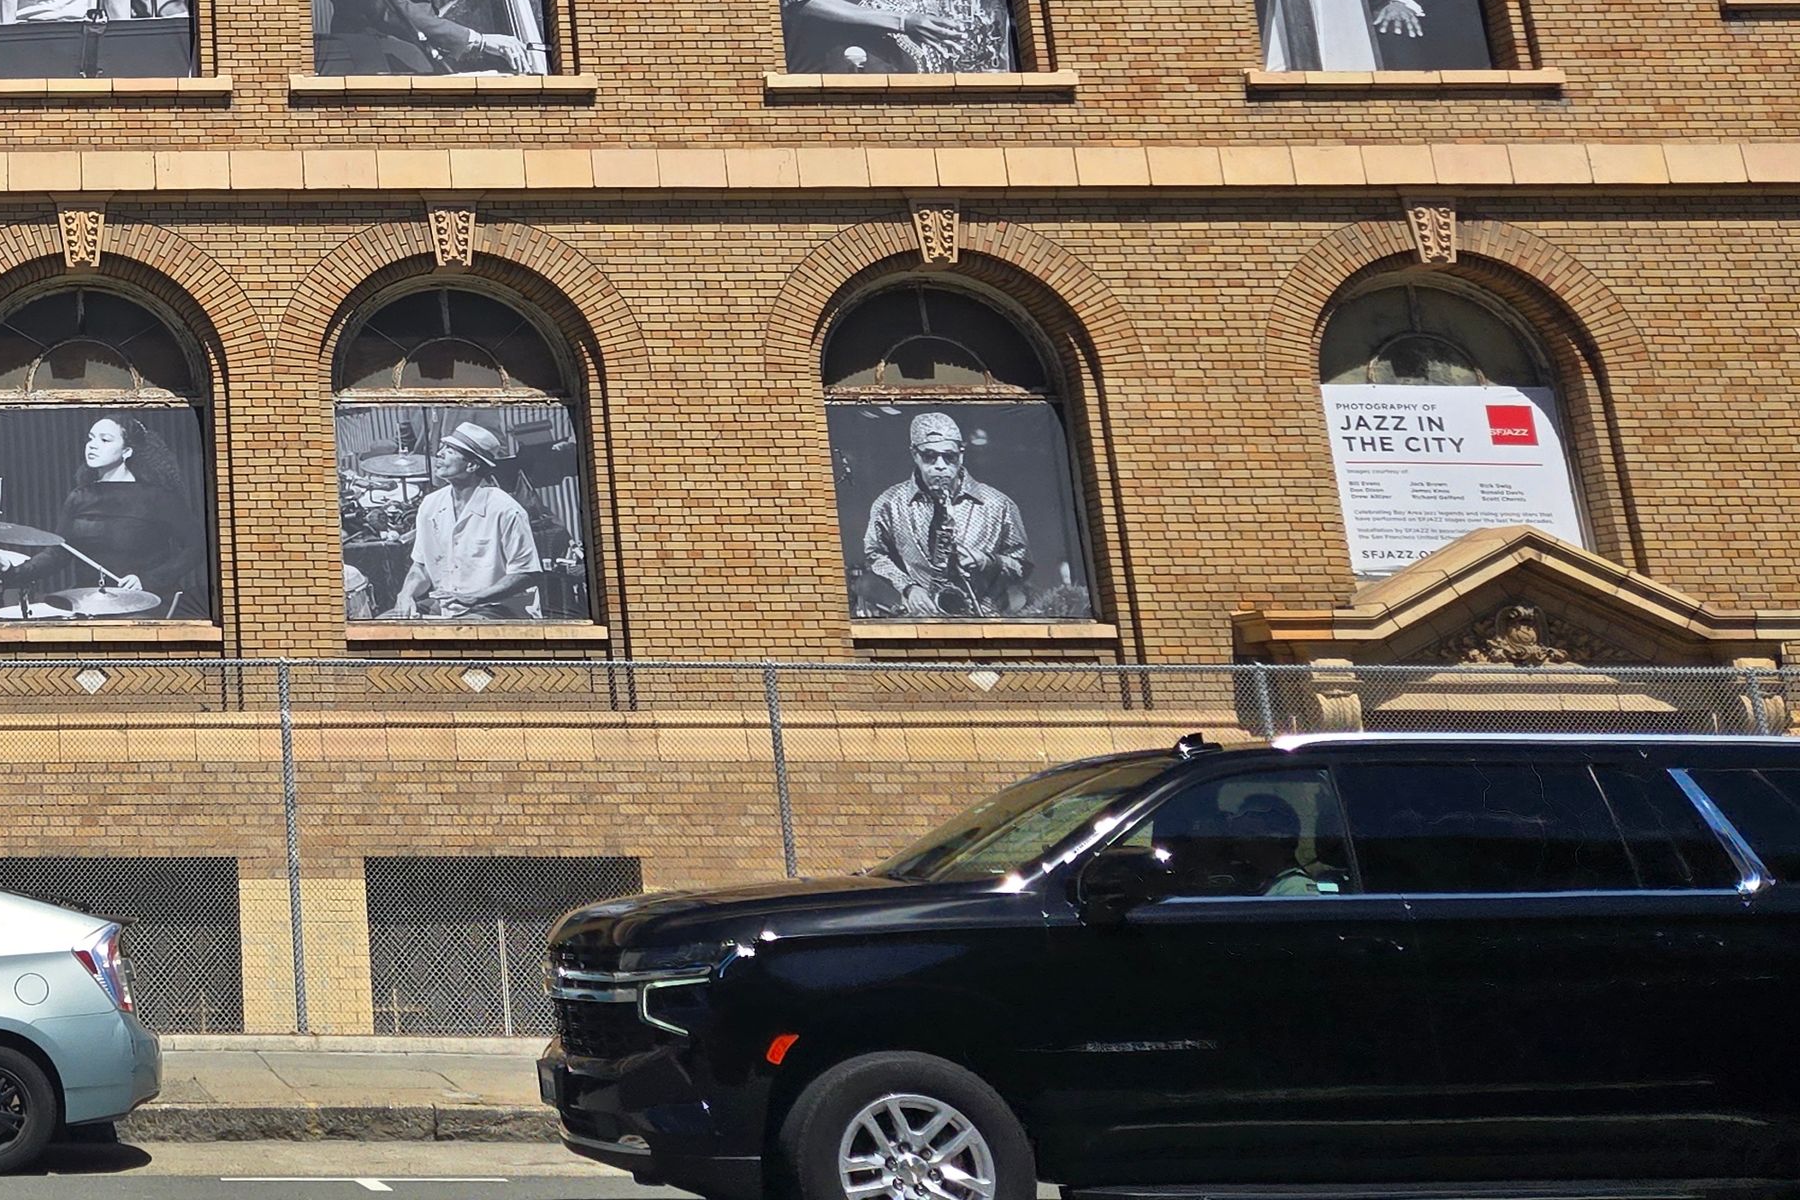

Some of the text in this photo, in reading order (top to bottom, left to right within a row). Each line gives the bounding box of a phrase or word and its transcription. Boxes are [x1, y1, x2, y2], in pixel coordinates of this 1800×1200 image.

[1336, 403, 1417, 411] PHOTOGRAPHY
[1340, 415, 1445, 432] JAZZ IN
[1489, 428, 1529, 436] SFJAZZ
[1342, 436, 1464, 453] THE CITY
